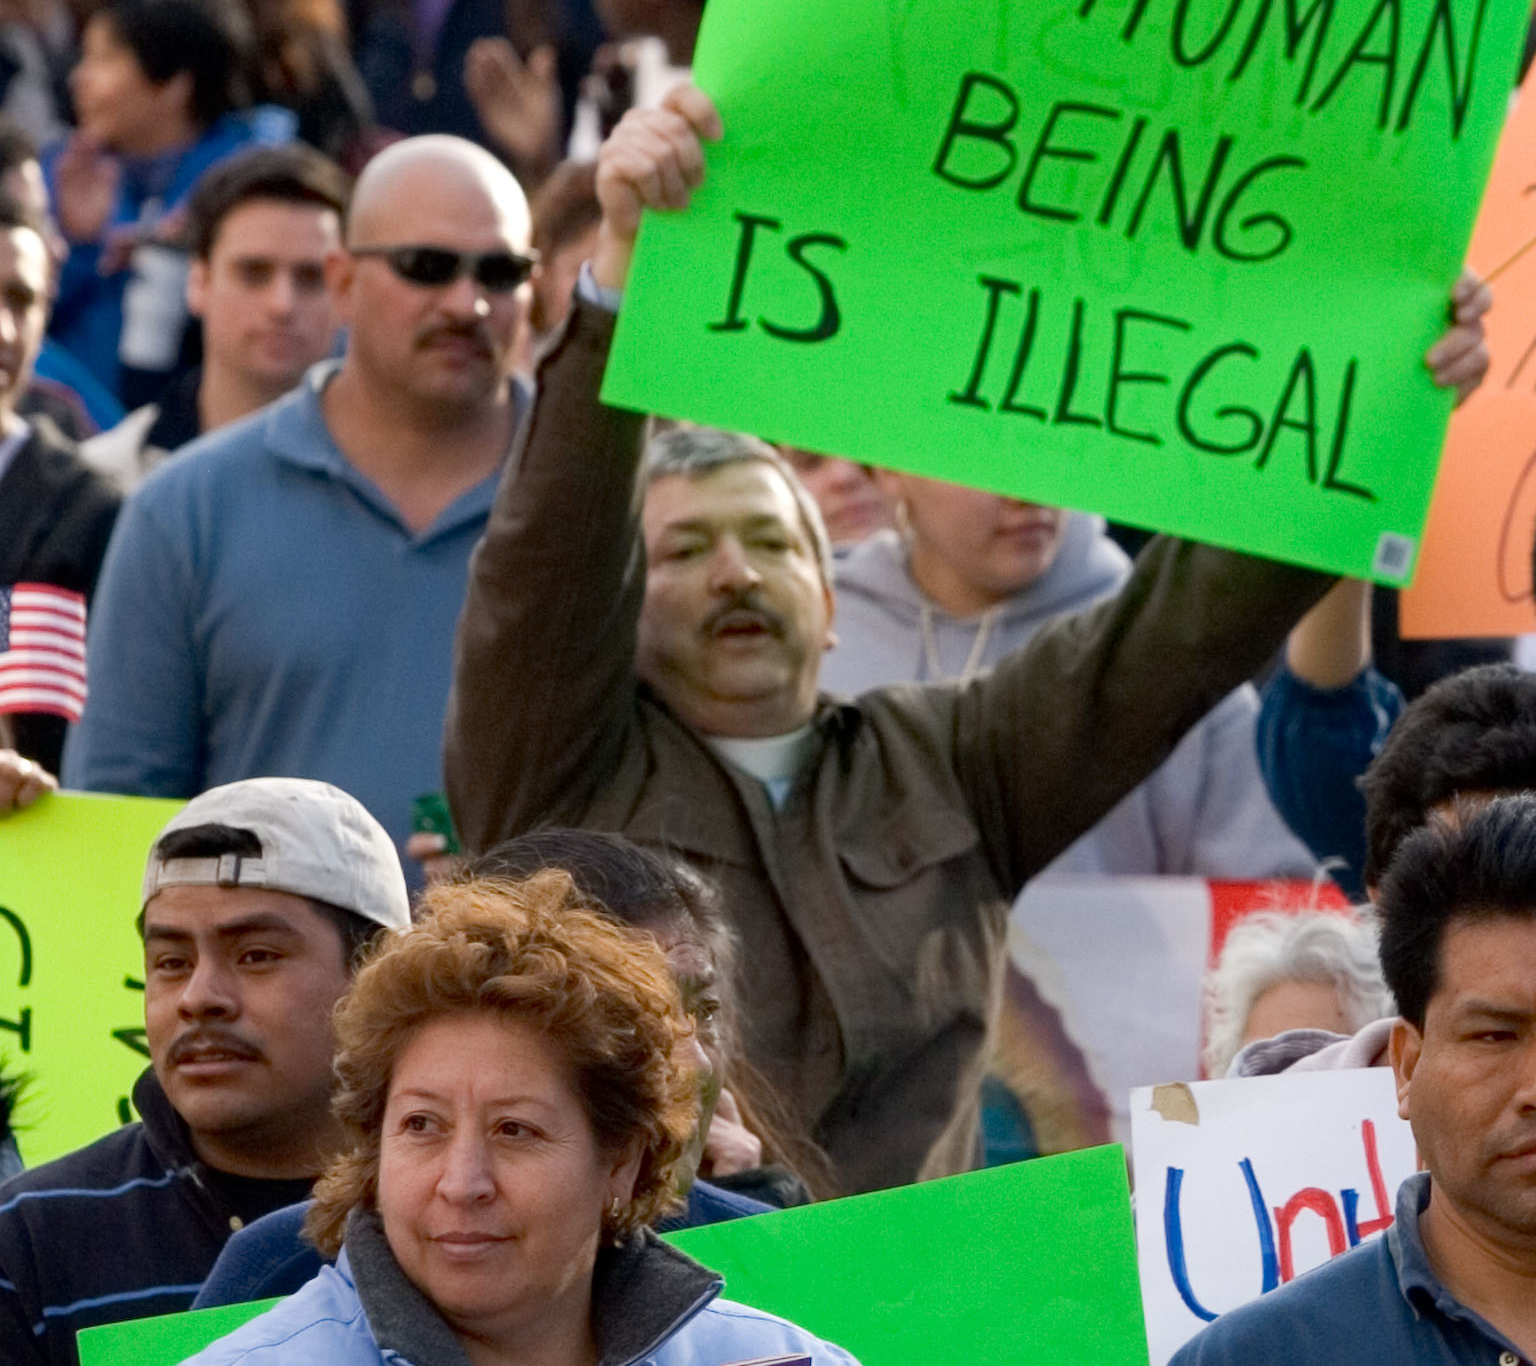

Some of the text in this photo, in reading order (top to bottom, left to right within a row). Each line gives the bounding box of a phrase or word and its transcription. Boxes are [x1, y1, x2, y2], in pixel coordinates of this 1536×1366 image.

[934, 74, 1304, 260] BEING
[712, 215, 1371, 498] IS ILLEGAL
